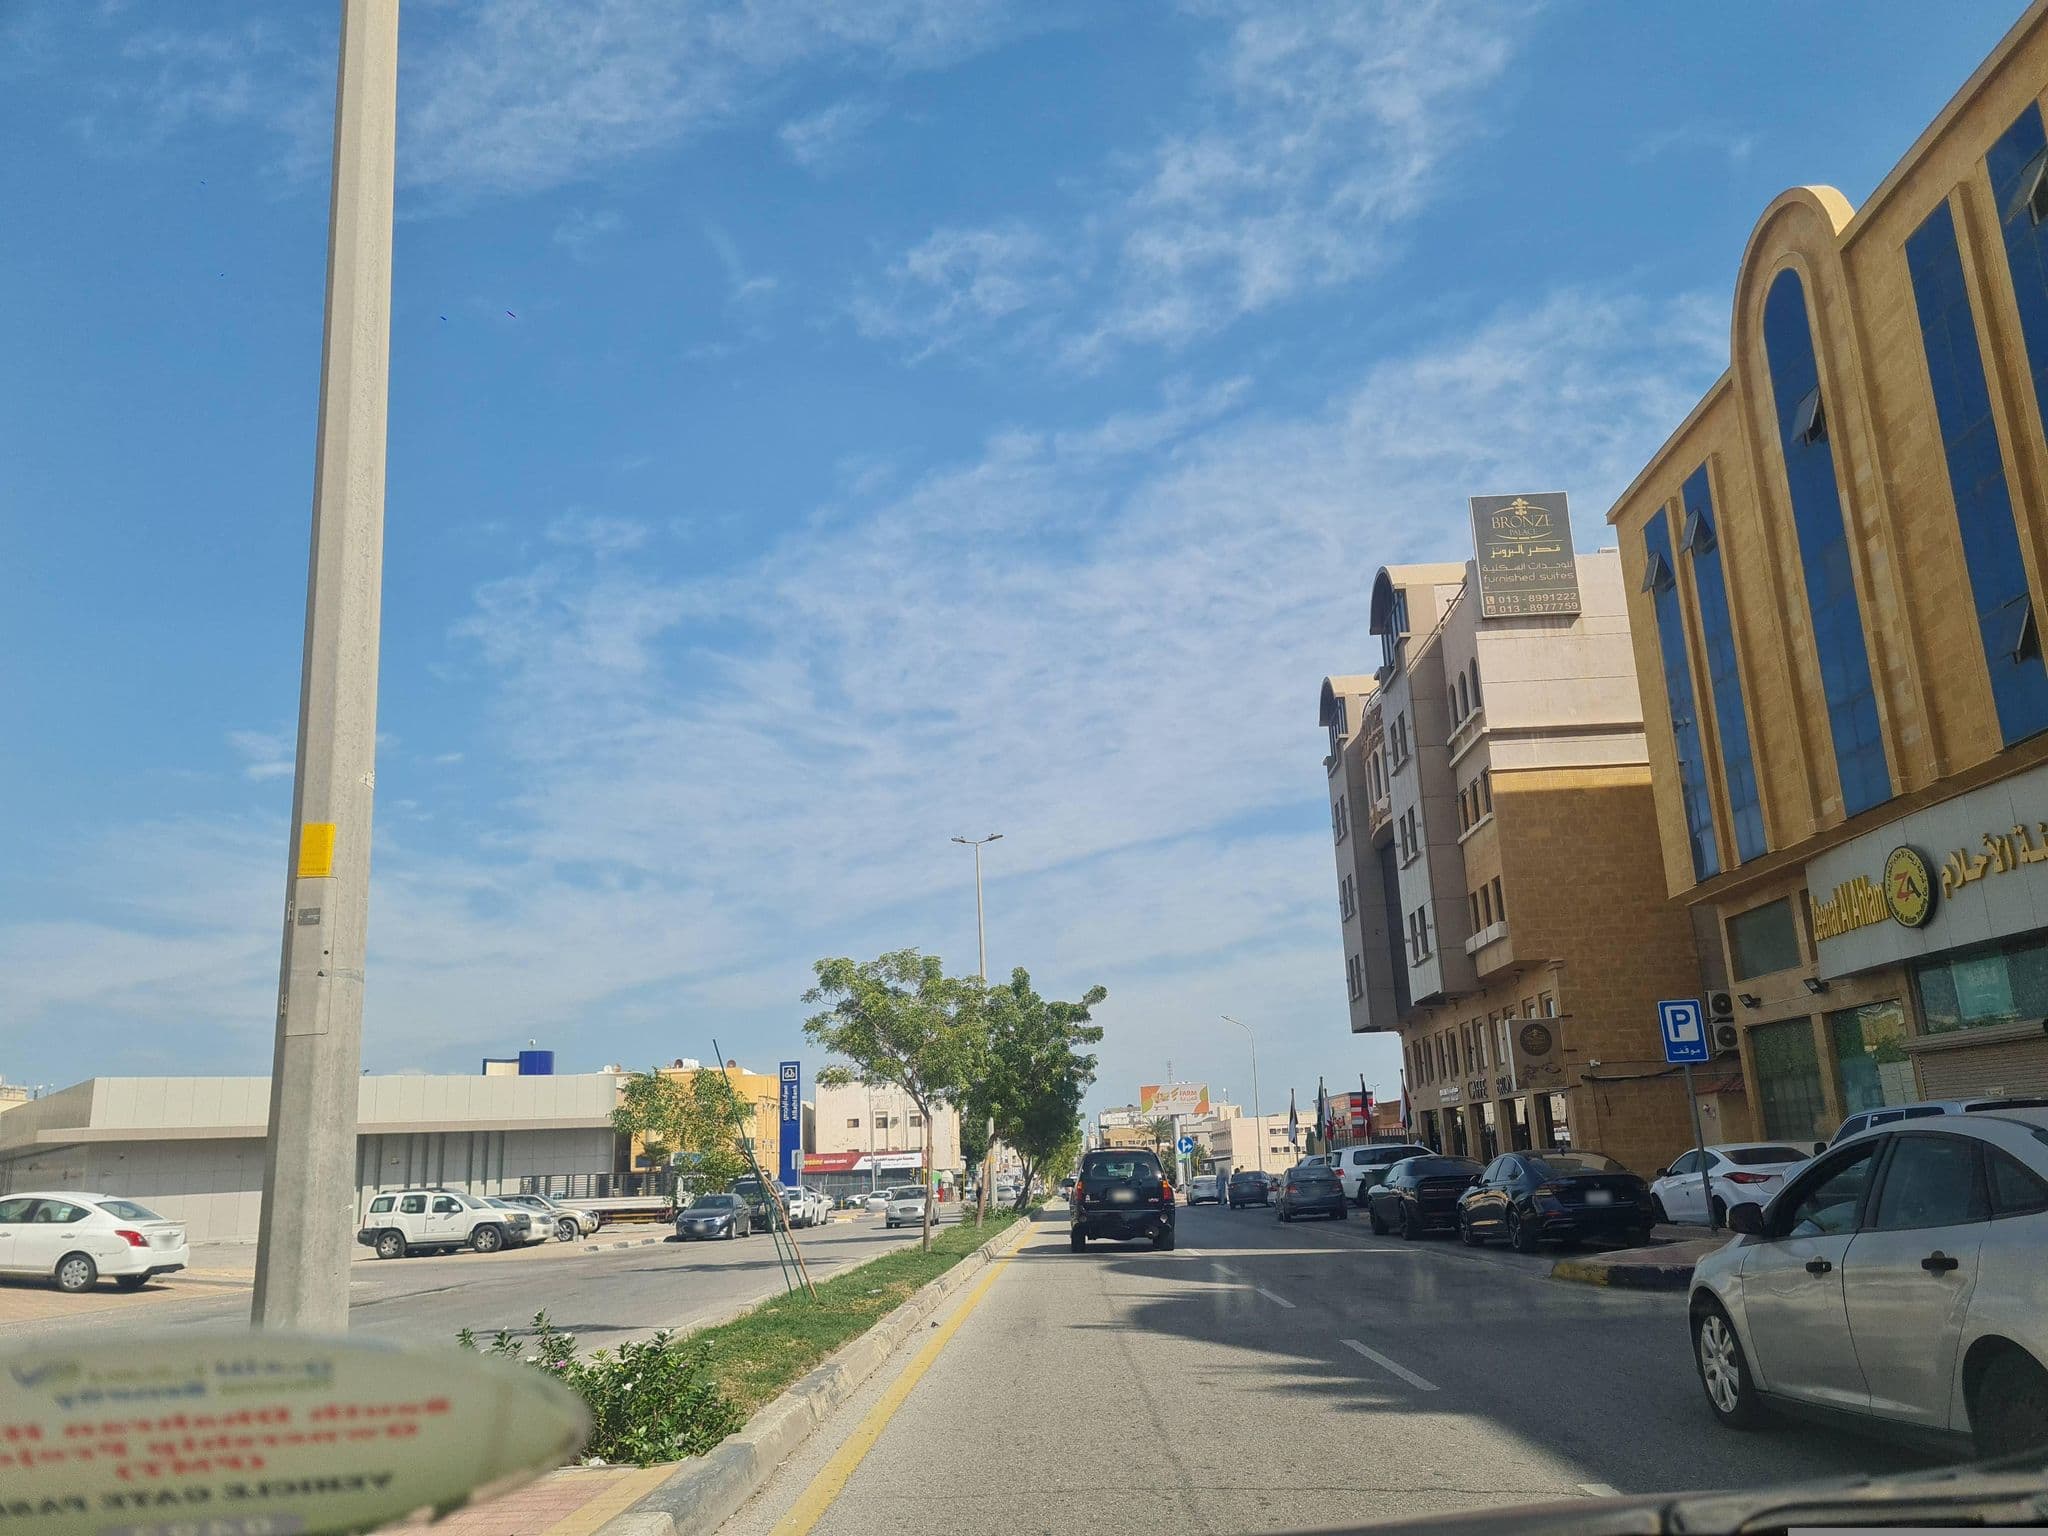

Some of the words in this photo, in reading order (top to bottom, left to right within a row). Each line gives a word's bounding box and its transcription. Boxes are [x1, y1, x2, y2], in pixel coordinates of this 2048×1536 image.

[1491, 514, 1553, 529] BRONZE
[1509, 528, 1537, 536] PALACE
[1528, 543, 1561, 557] قصر
[1483, 571, 1536, 583] furnished
[1539, 571, 1575, 581] suites
[1850, 875, 1891, 930] Ahlam
[1671, 1009, 1690, 1038] P
[1673, 1045, 1701, 1055] موقف
